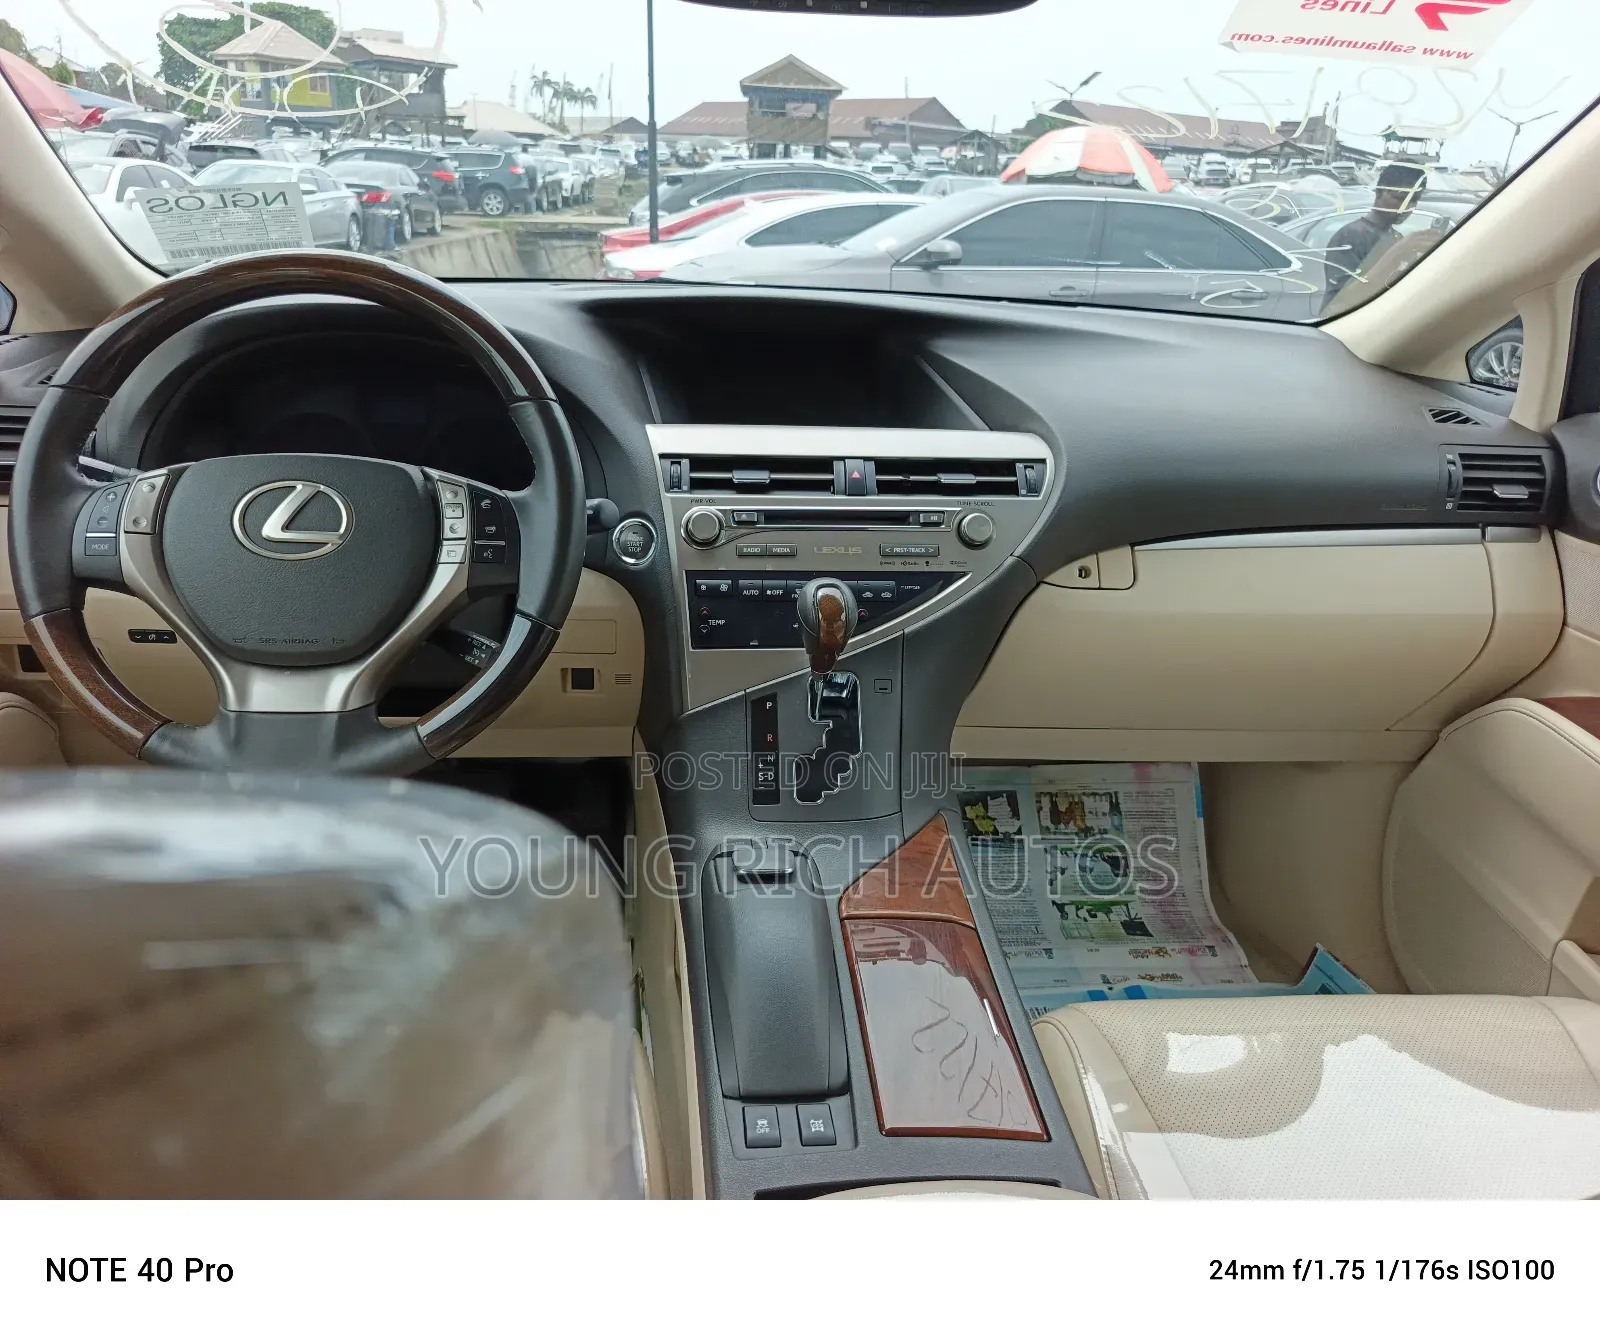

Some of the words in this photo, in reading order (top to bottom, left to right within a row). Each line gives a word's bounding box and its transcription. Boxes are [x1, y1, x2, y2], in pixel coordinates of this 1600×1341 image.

[813, 546, 863, 555] LEXUS
[281, 637, 320, 645] AIRBAG
[766, 701, 773, 710] P
[767, 733, 773, 741] R
[767, 754, 774, 762] N
